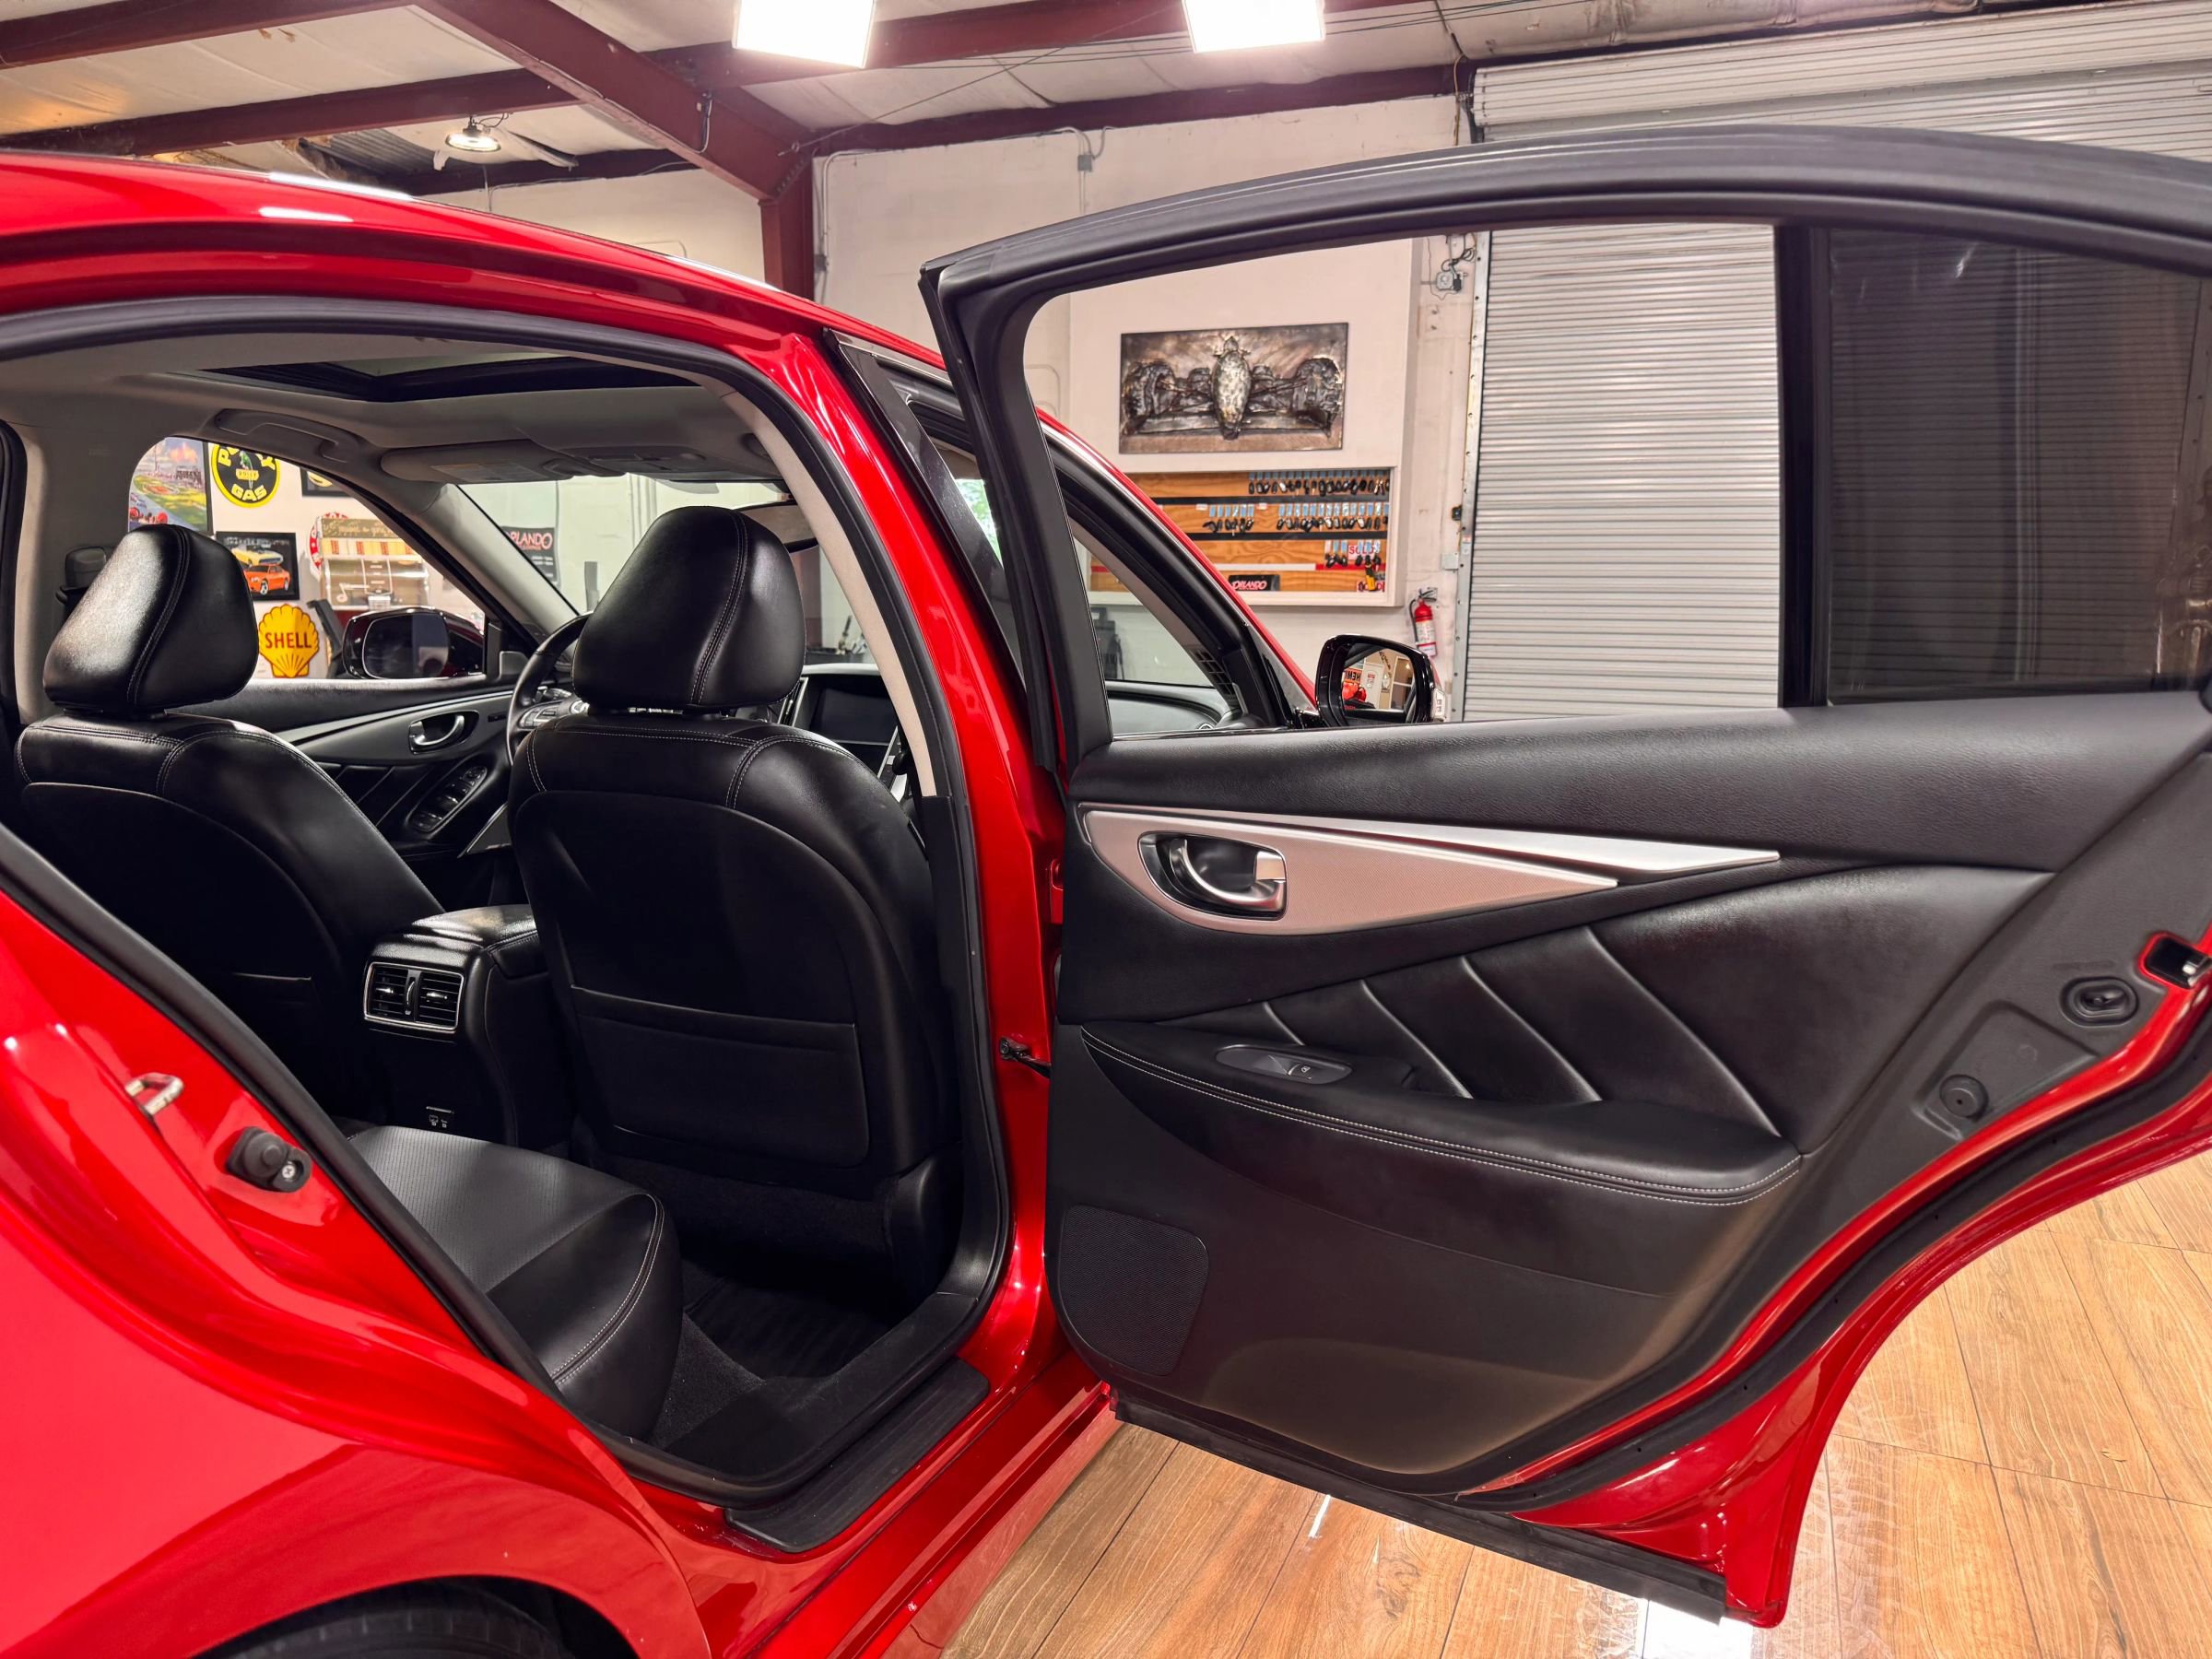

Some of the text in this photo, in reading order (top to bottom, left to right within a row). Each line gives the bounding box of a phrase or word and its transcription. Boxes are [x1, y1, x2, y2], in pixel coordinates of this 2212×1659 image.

[231, 484, 267, 501] GAS
[505, 531, 553, 549] RLANDO
[265, 632, 312, 649] SHELL
